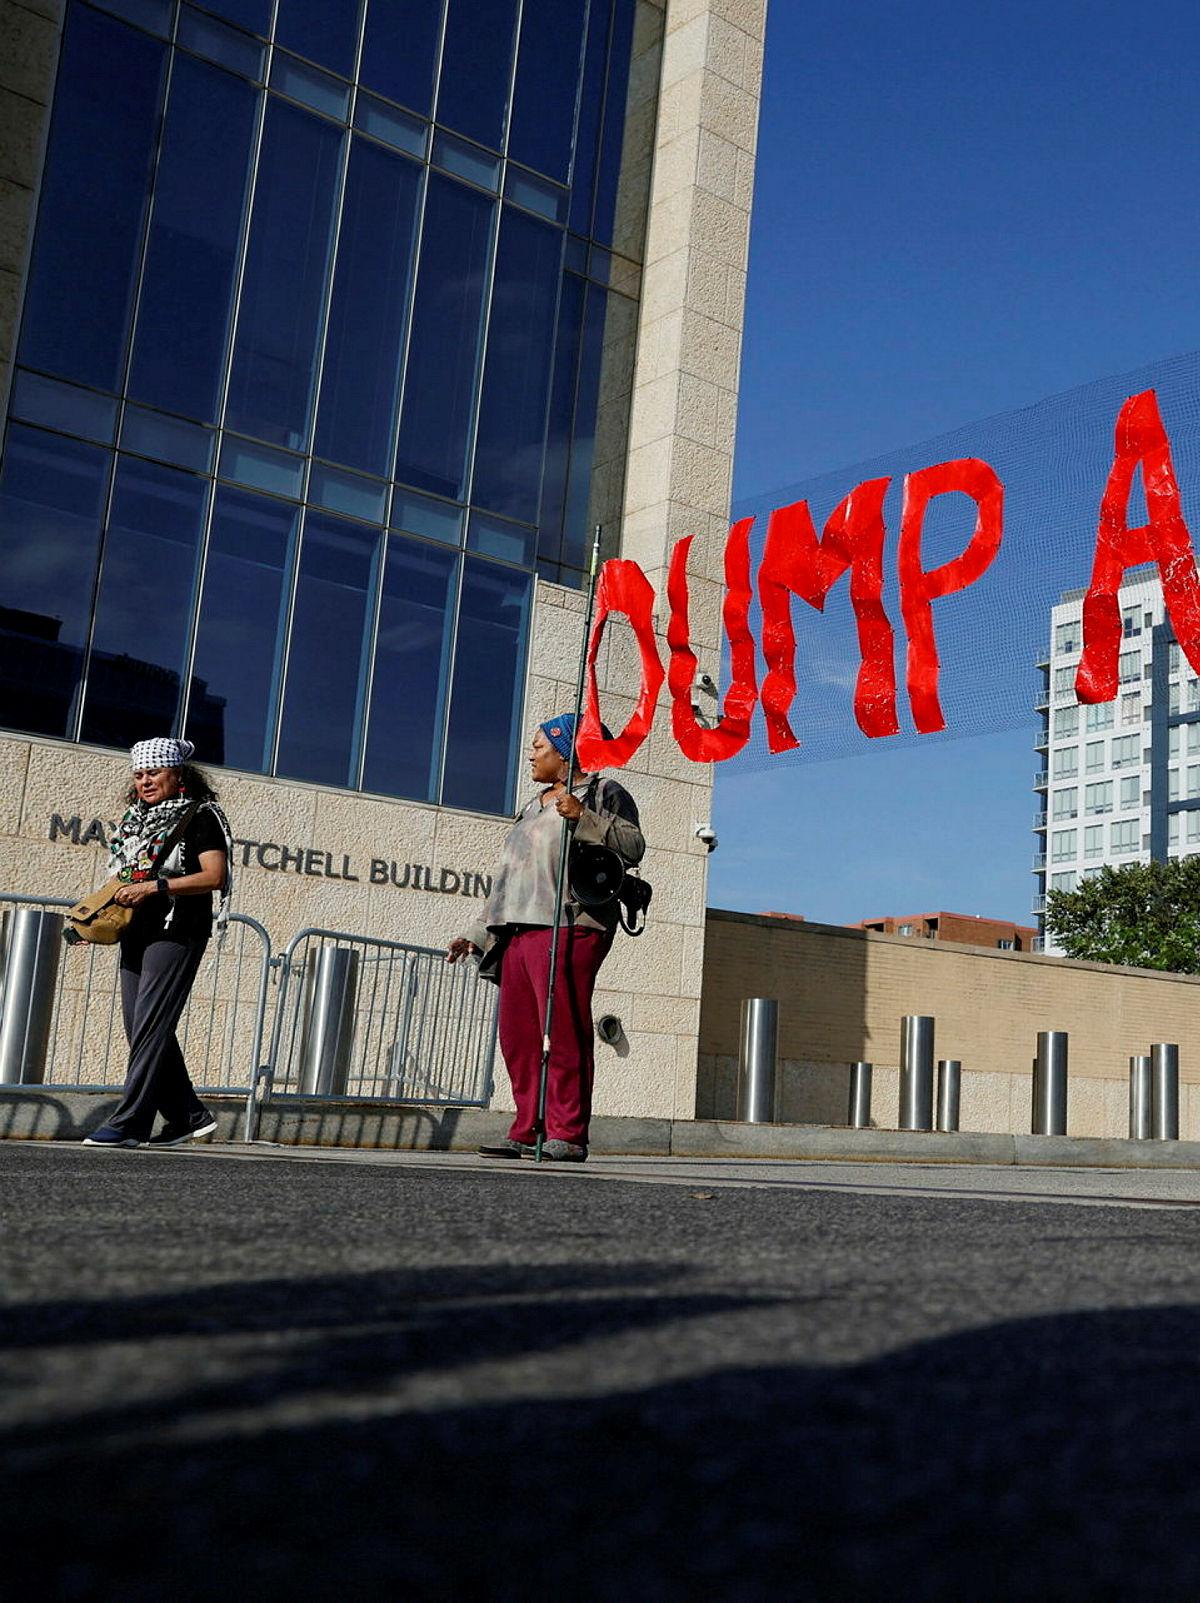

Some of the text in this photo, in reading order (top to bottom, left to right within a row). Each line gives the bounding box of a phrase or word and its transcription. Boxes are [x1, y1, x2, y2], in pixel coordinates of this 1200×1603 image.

[576, 458, 1004, 773] DUMP
[233, 838, 359, 882] TCHELL
[369, 858, 493, 899] BUILDIN
